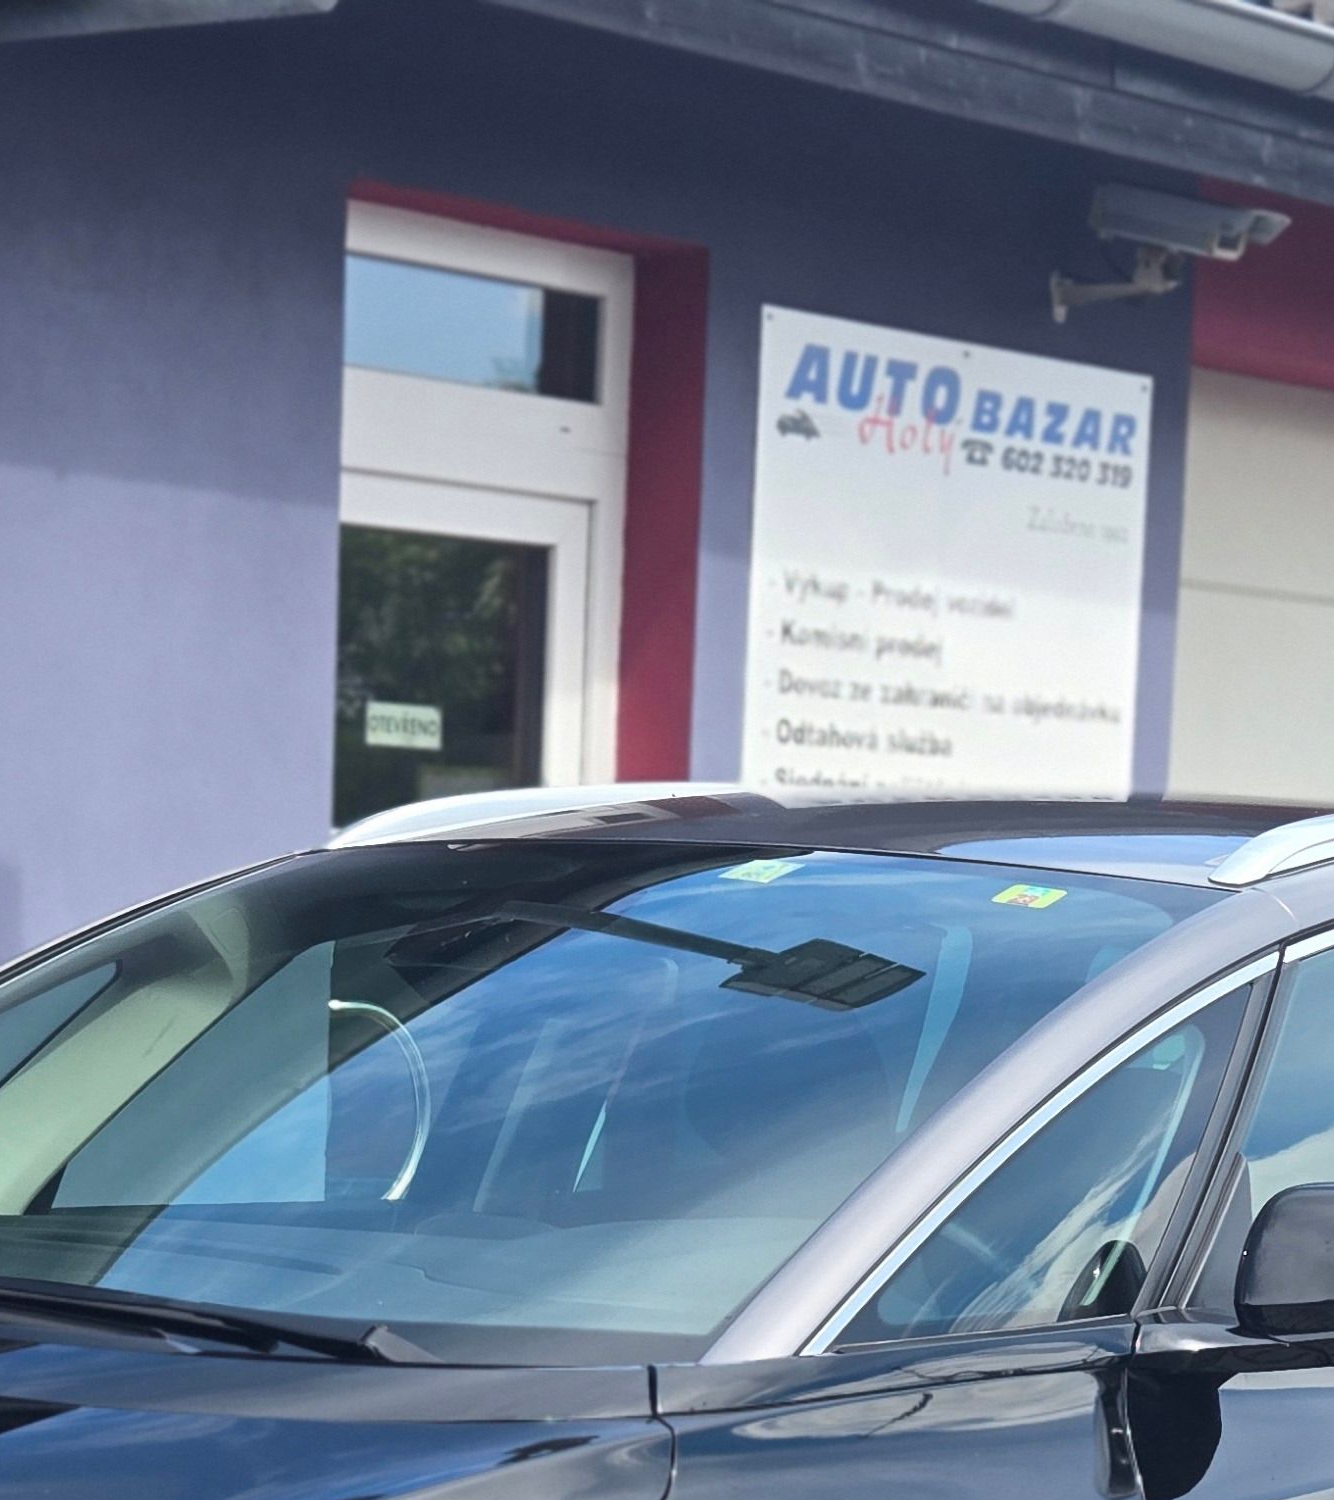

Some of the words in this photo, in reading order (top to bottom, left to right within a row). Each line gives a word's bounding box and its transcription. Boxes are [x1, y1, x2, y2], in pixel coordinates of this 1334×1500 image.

[784, 343, 962, 426] AUTO
[970, 388, 1138, 456] BAZAR
[1001, 446, 1045, 475] 602
[1049, 453, 1092, 482] 320
[1095, 461, 1134, 489] 319
[778, 667, 842, 699] Dovoz
